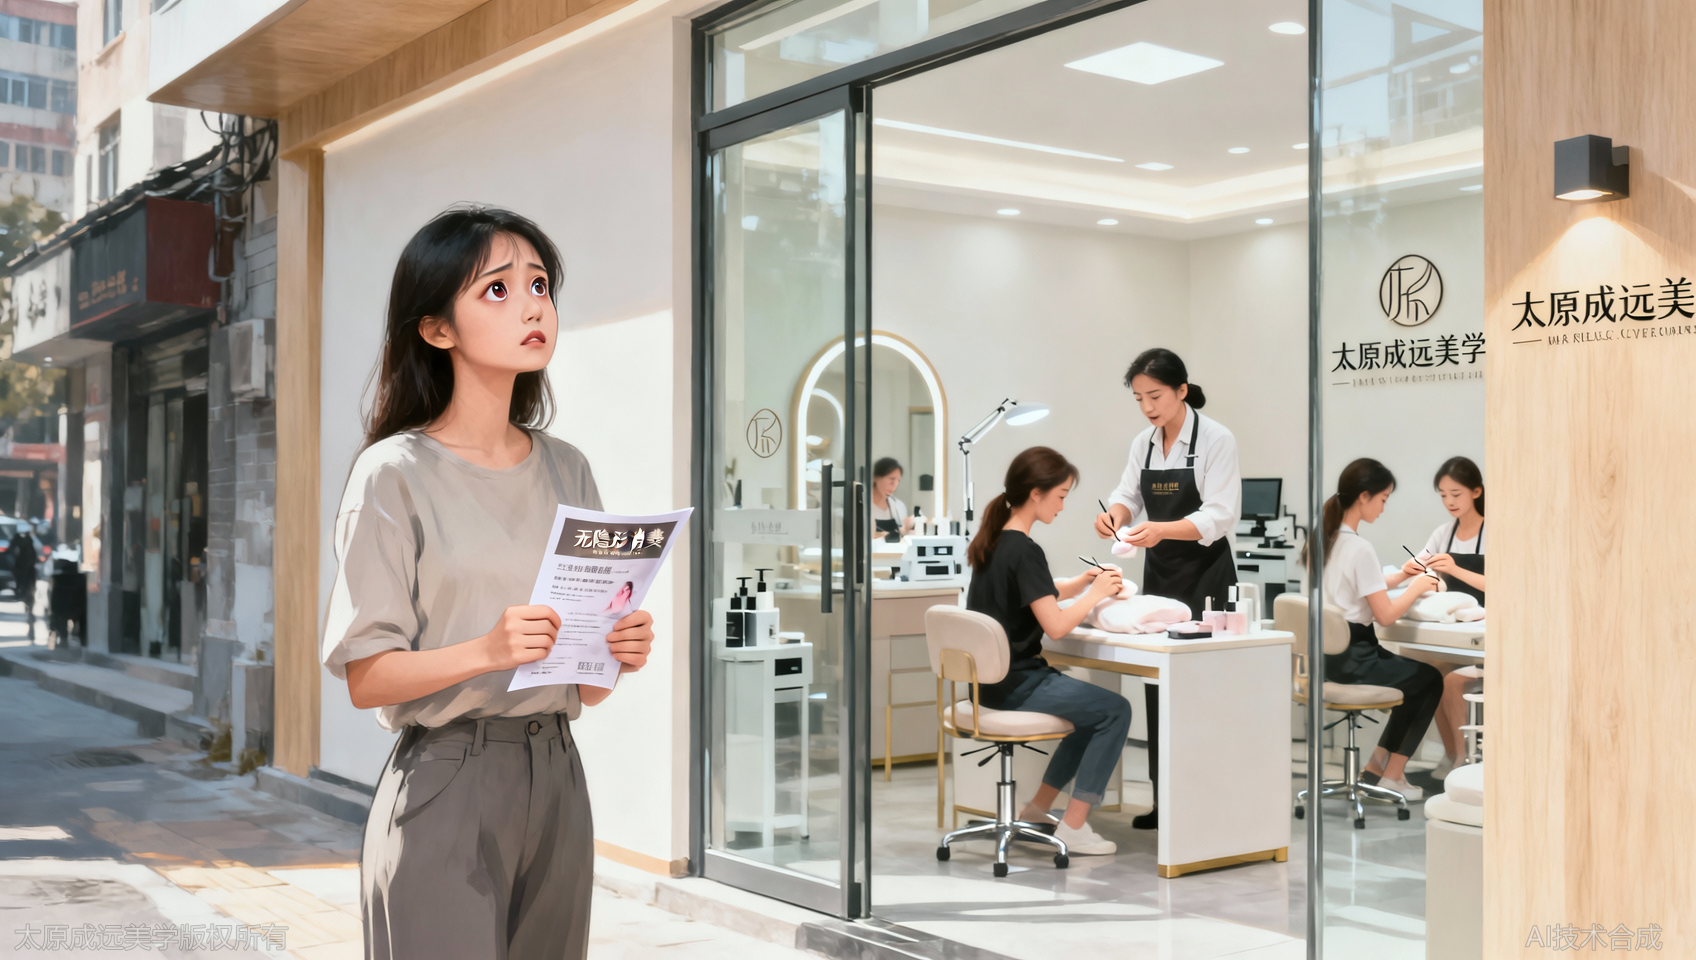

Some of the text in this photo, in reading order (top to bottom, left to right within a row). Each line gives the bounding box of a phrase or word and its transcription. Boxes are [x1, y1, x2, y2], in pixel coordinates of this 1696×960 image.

[1511, 276, 1696, 332] 太原成远美
[1331, 331, 1487, 373] 太原成远美学
